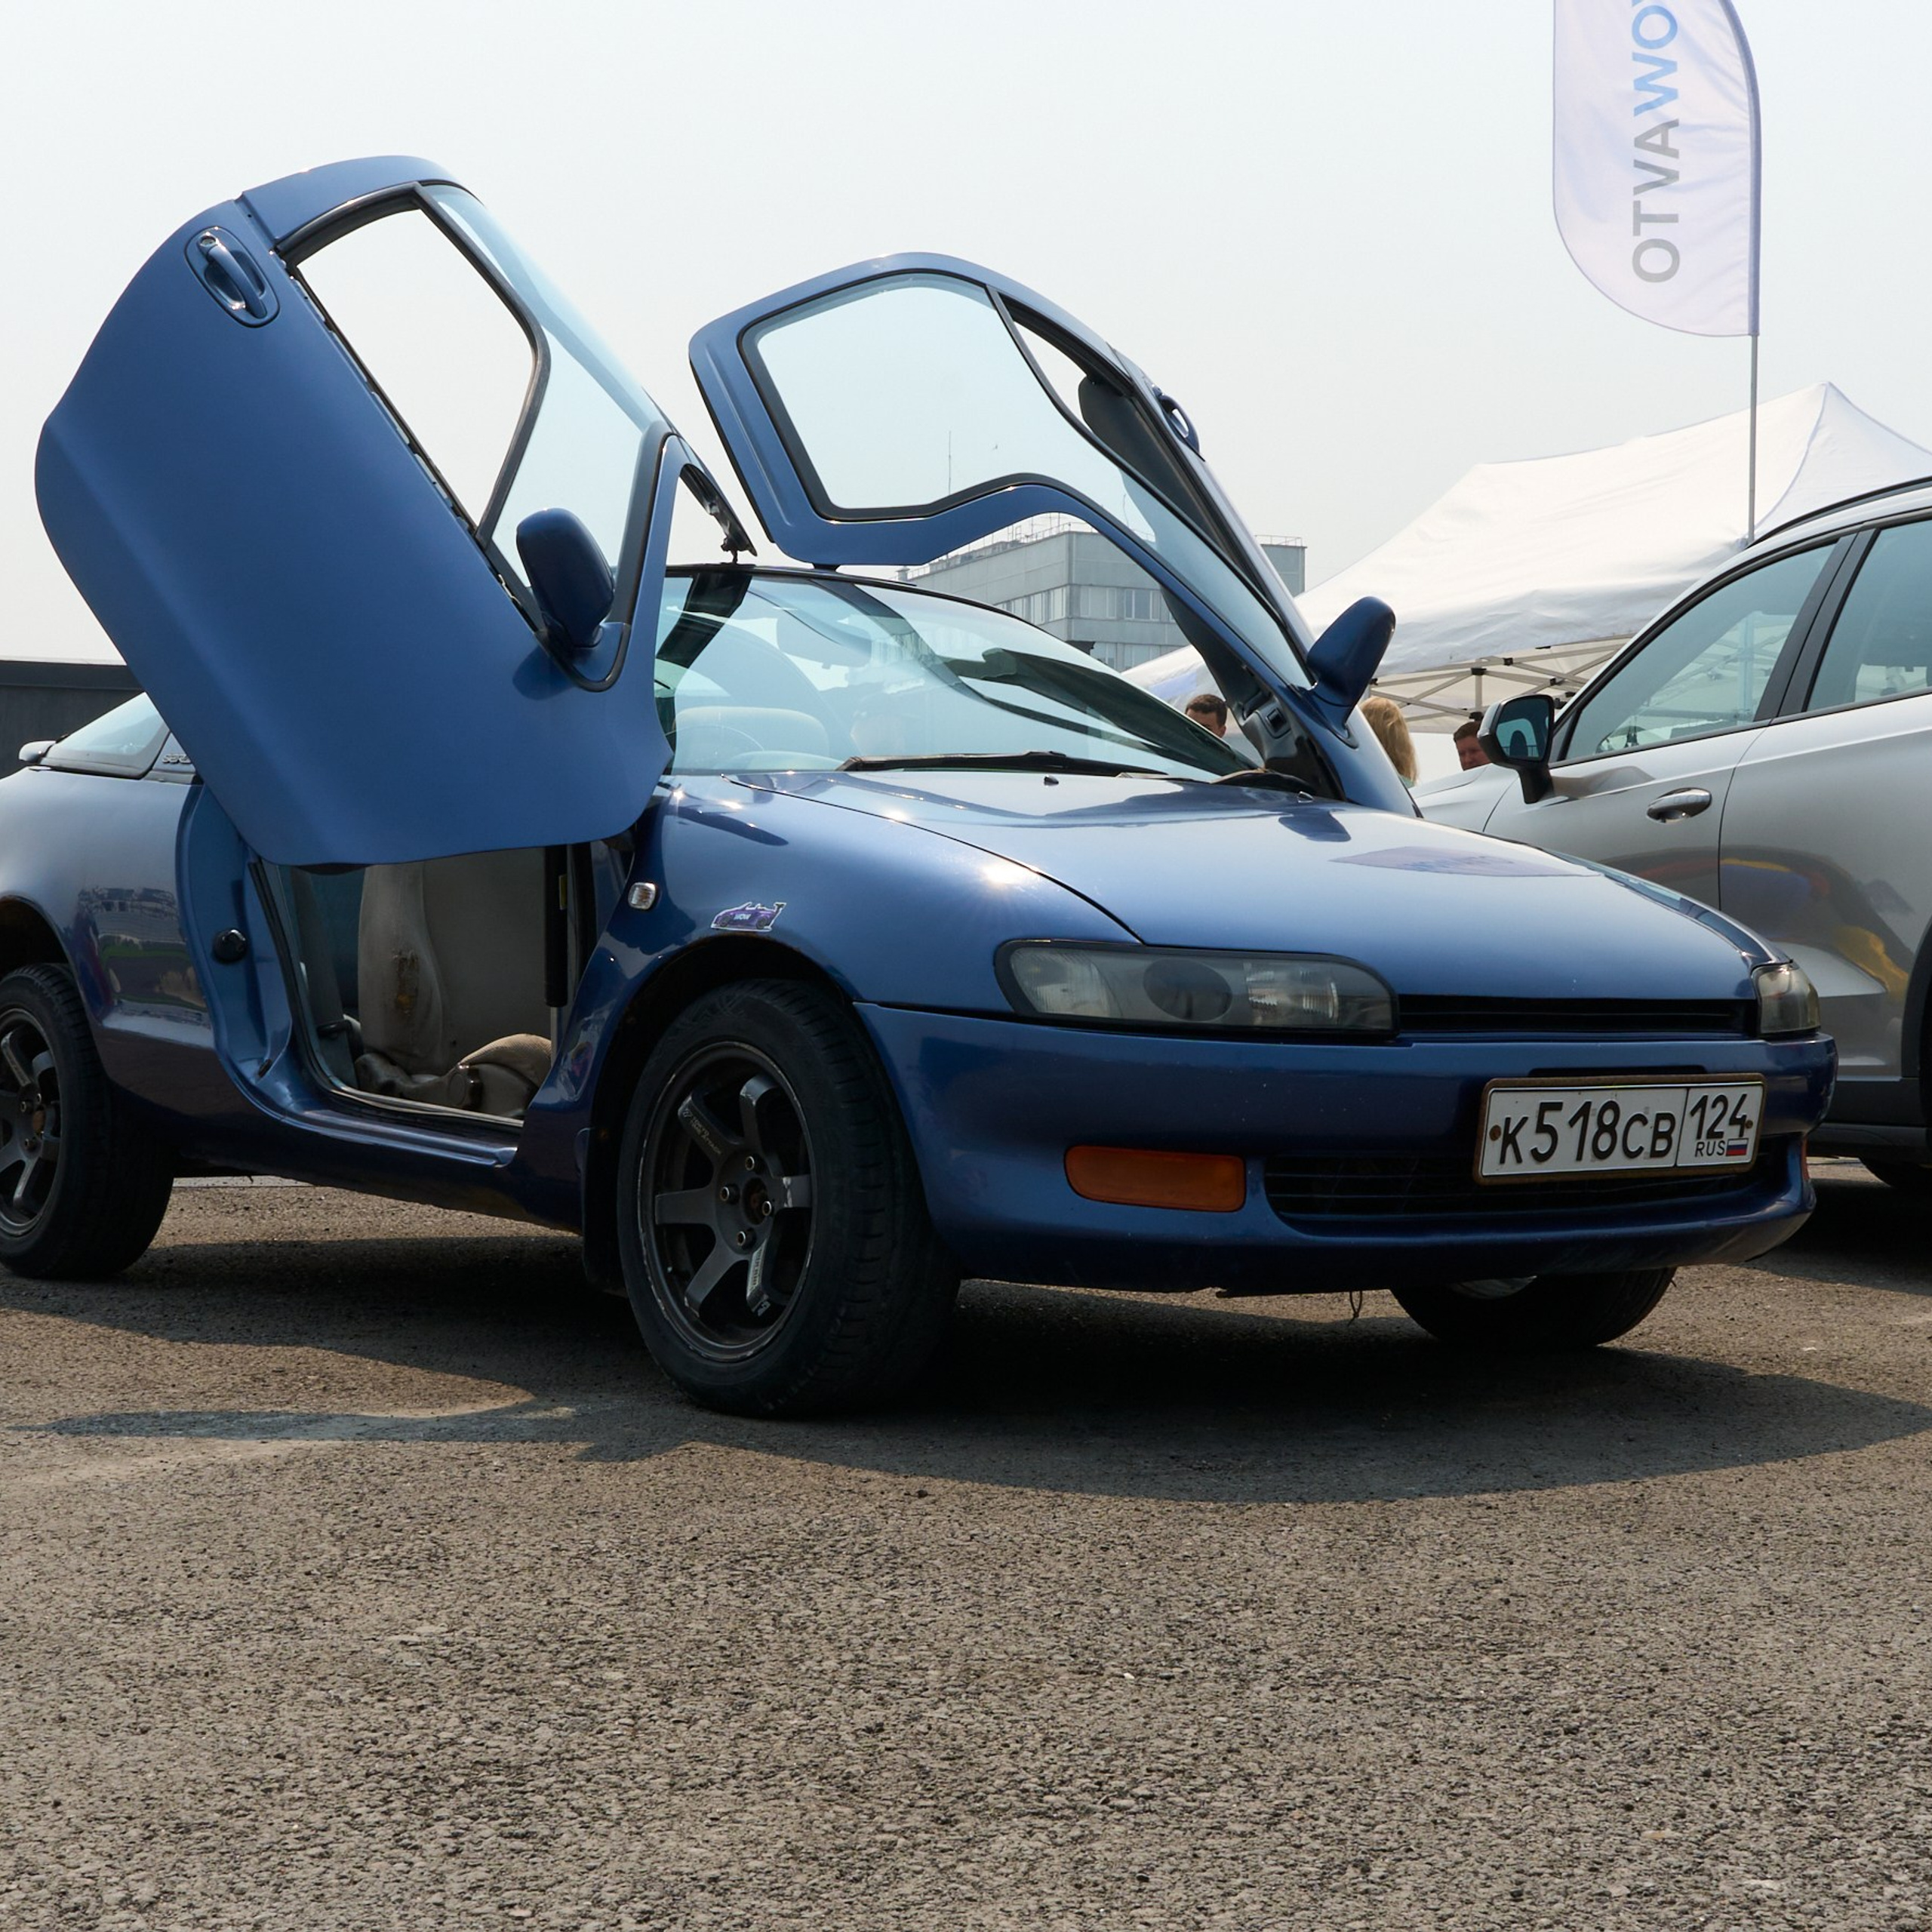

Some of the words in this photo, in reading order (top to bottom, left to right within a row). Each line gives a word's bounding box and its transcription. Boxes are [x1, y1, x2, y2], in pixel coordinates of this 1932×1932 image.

[1499, 1100, 1676, 1164] K518CB
[1690, 1094, 1748, 1141] 124
[1695, 1139, 1725, 1157] RUS
